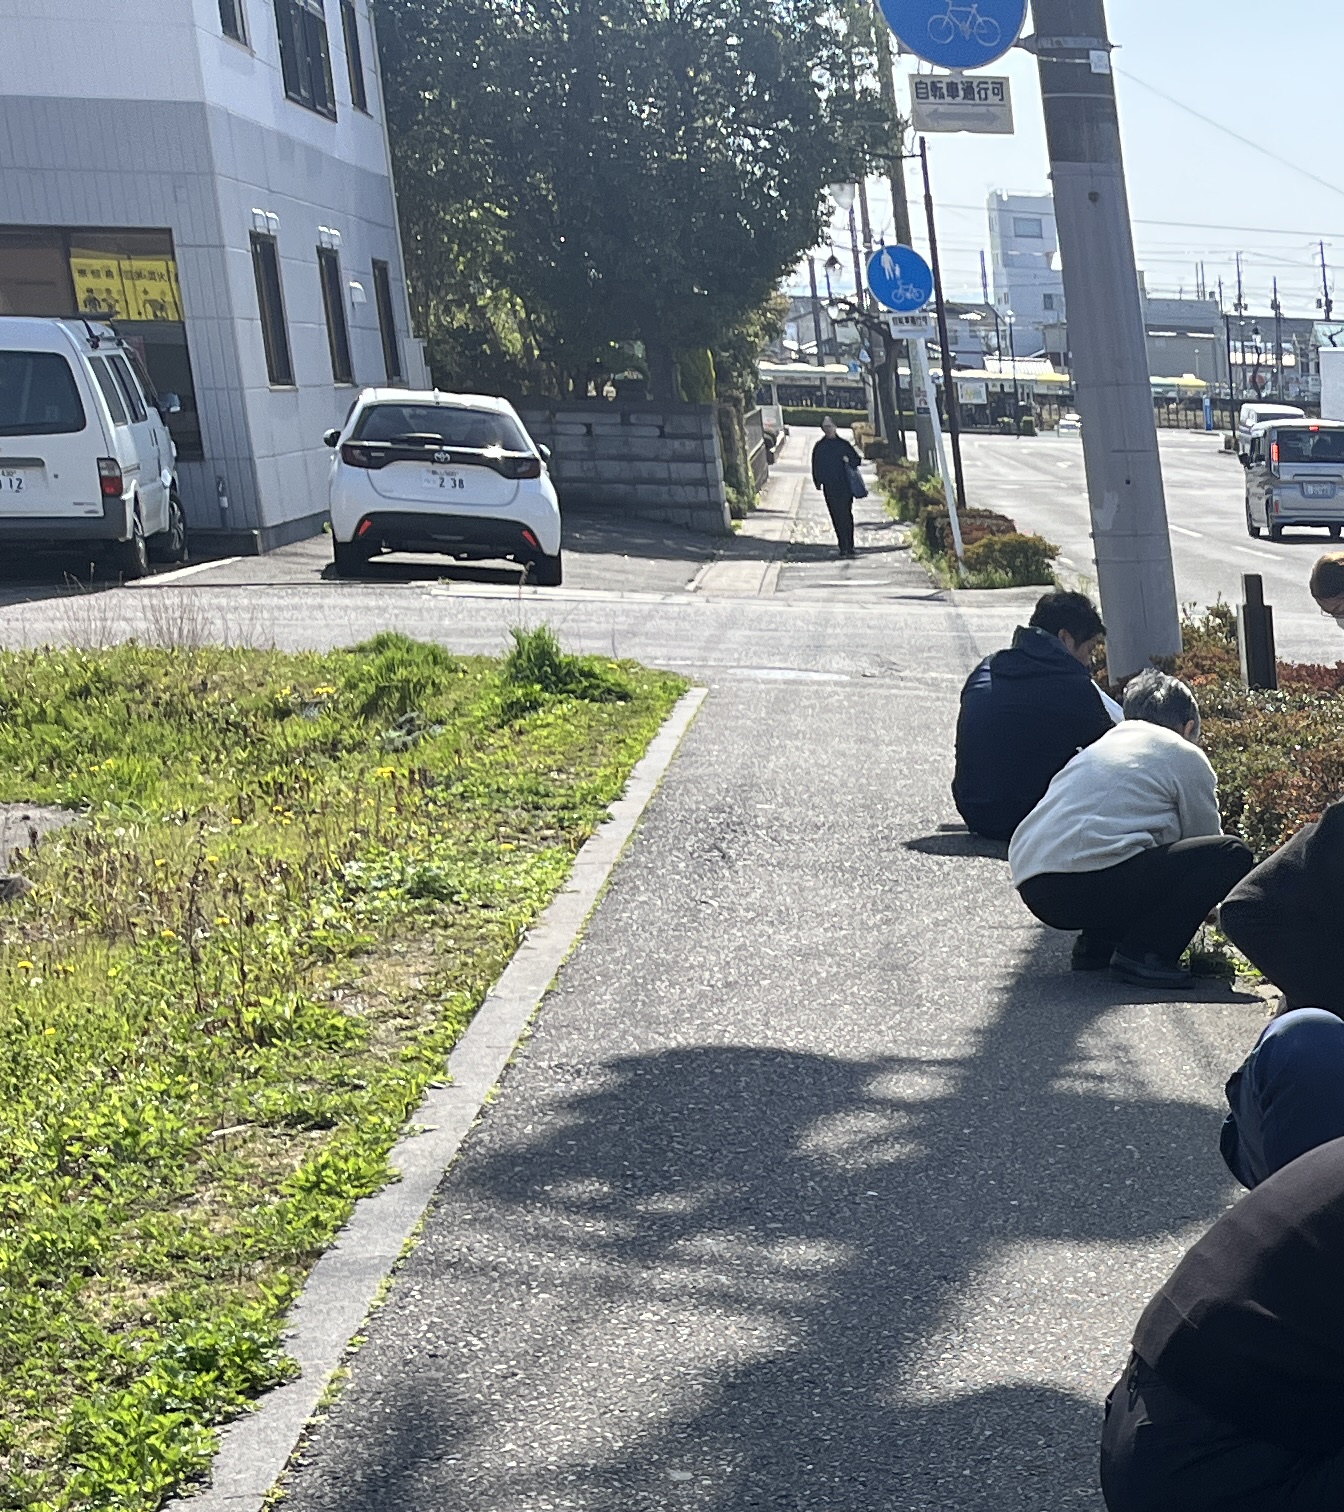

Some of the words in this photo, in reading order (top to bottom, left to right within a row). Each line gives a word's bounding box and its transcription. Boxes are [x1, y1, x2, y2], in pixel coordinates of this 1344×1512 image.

[914, 80, 1004, 101] 自転車通行可
[0, 477, 23, 490] 12
